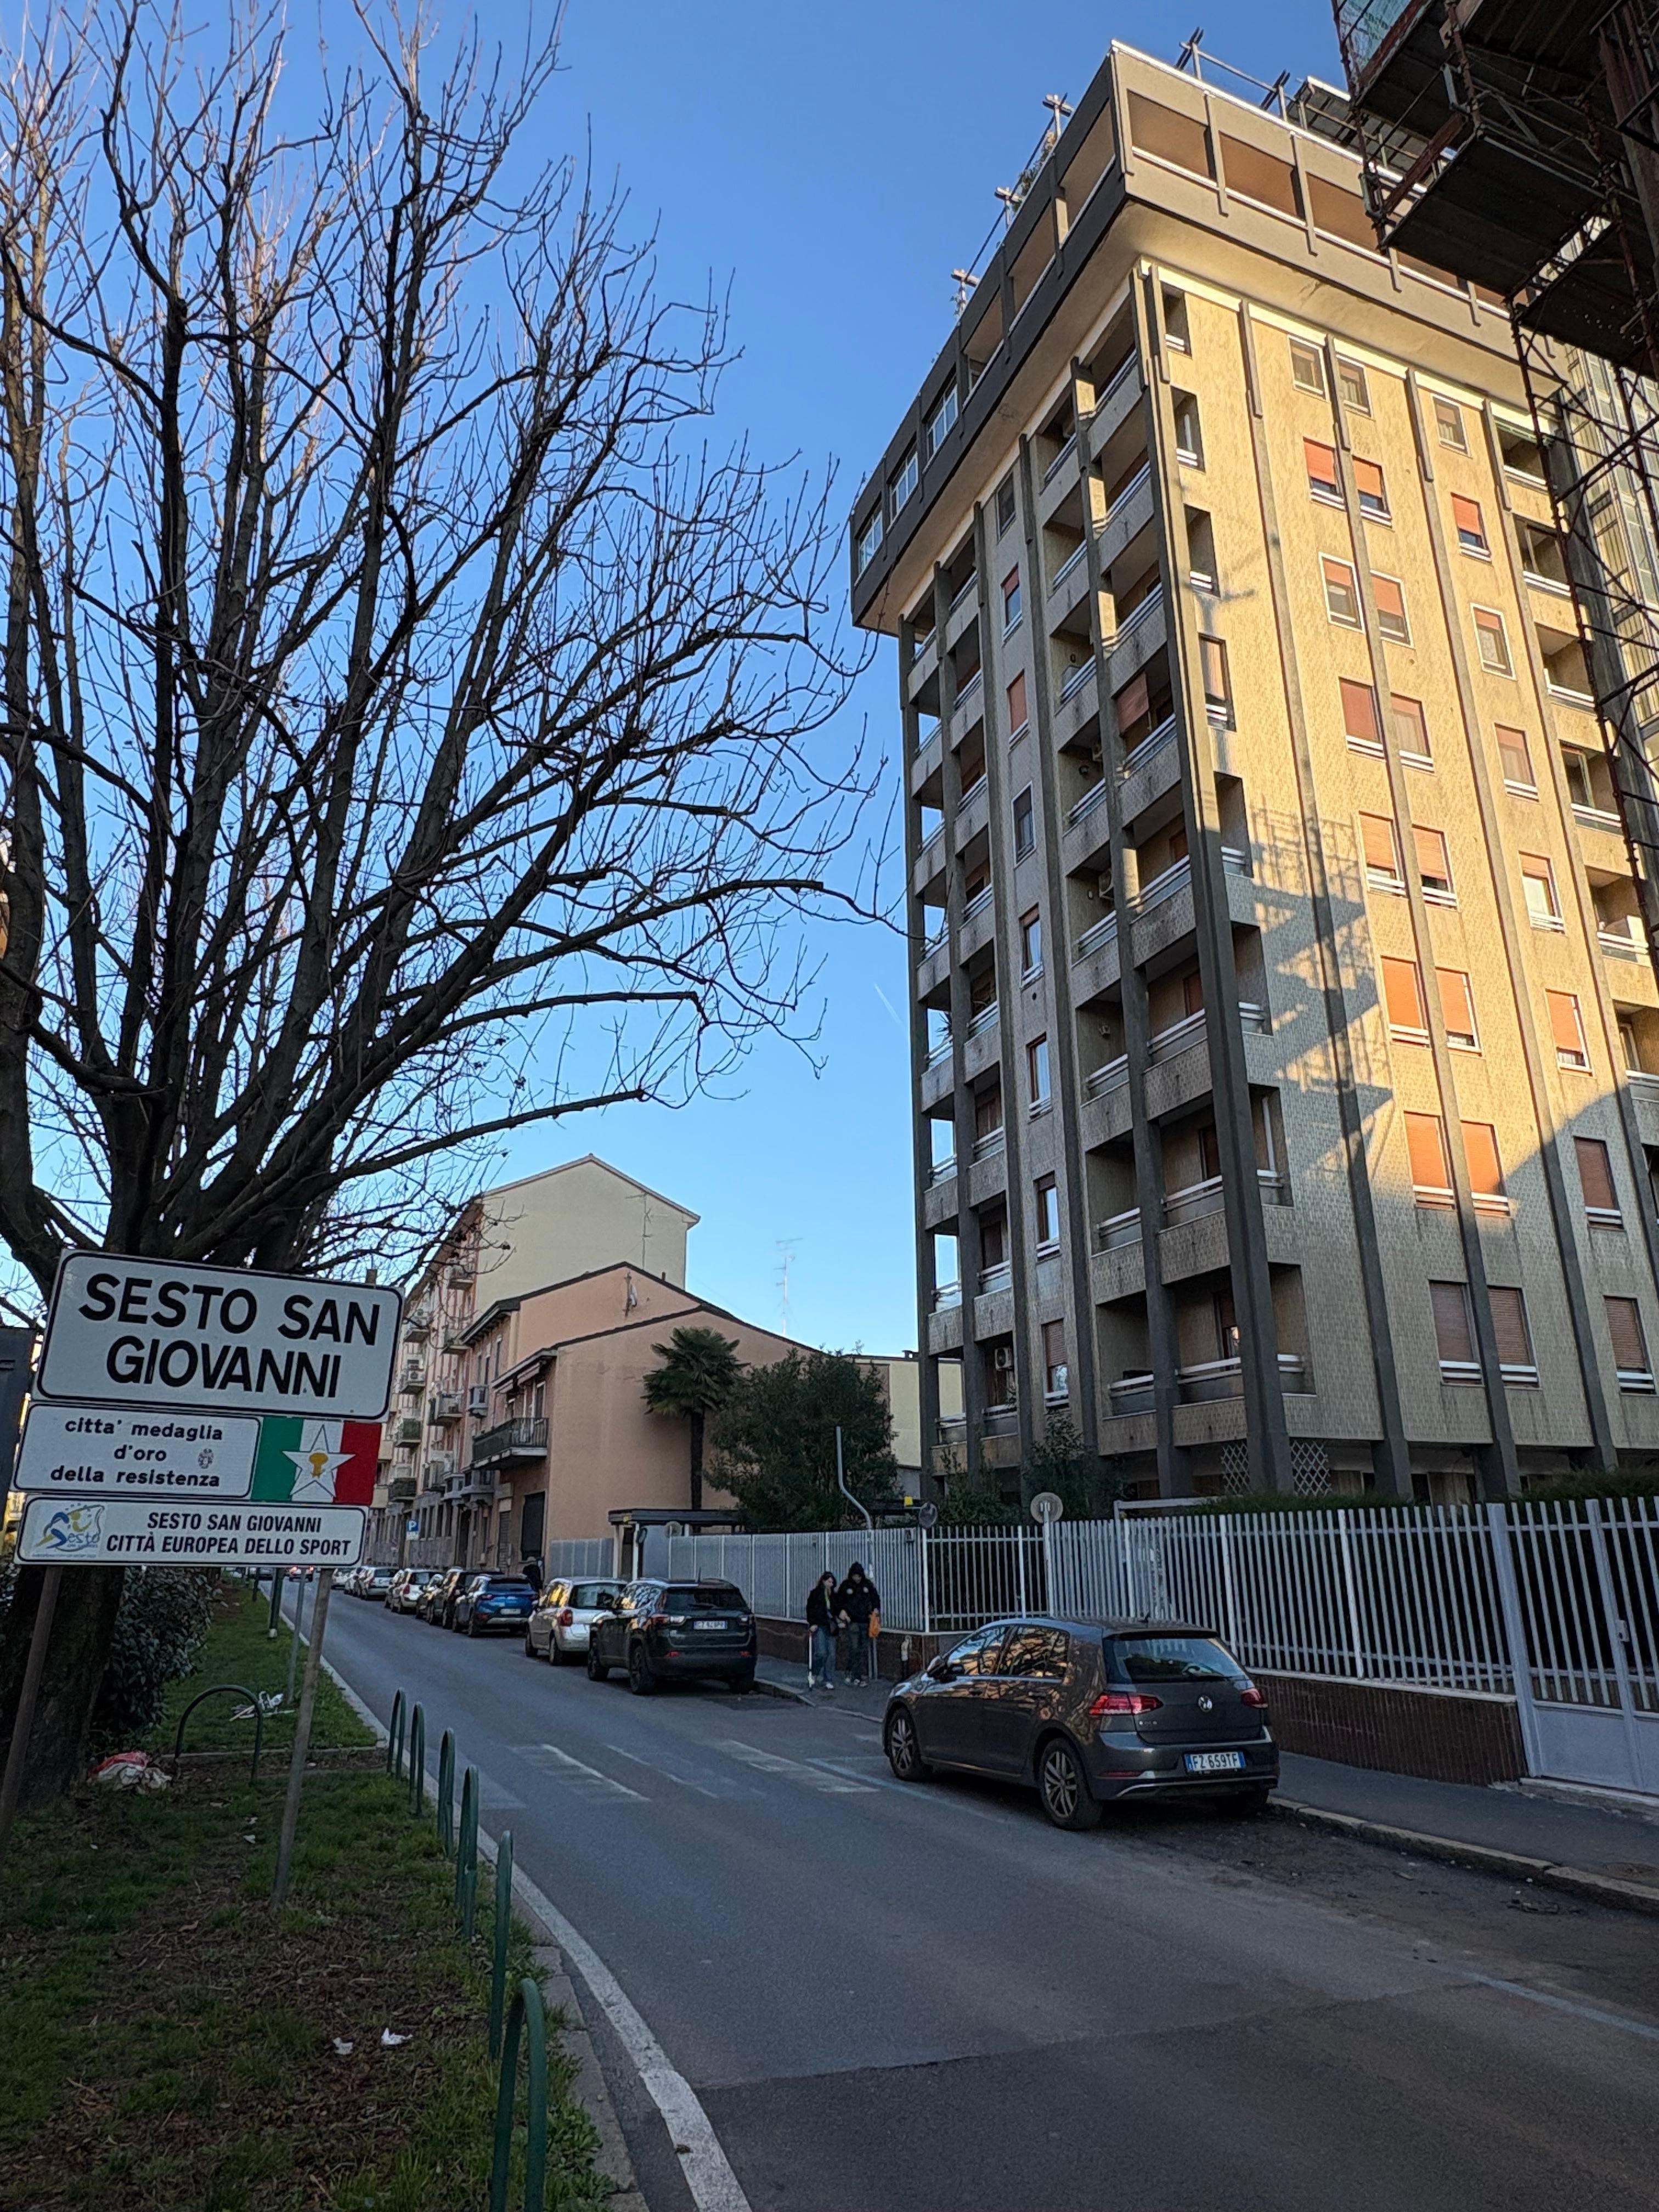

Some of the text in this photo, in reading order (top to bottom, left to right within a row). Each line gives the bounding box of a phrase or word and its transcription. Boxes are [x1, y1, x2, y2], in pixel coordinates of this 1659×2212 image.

[79, 1273, 380, 1346] SESTO SAN
[107, 1335, 341, 1398] GIOVANNI
[65, 1417, 222, 1441] citta' medaglia
[114, 1444, 166, 1461] d'oro
[50, 1465, 219, 1487] della resistenza
[148, 1512, 321, 1532] SESTO SAN GIOVANNI
[408, 1521, 417, 1531] P
[106, 1531, 351, 1555] CITTÀ EUROPEA DELLO SPORT
